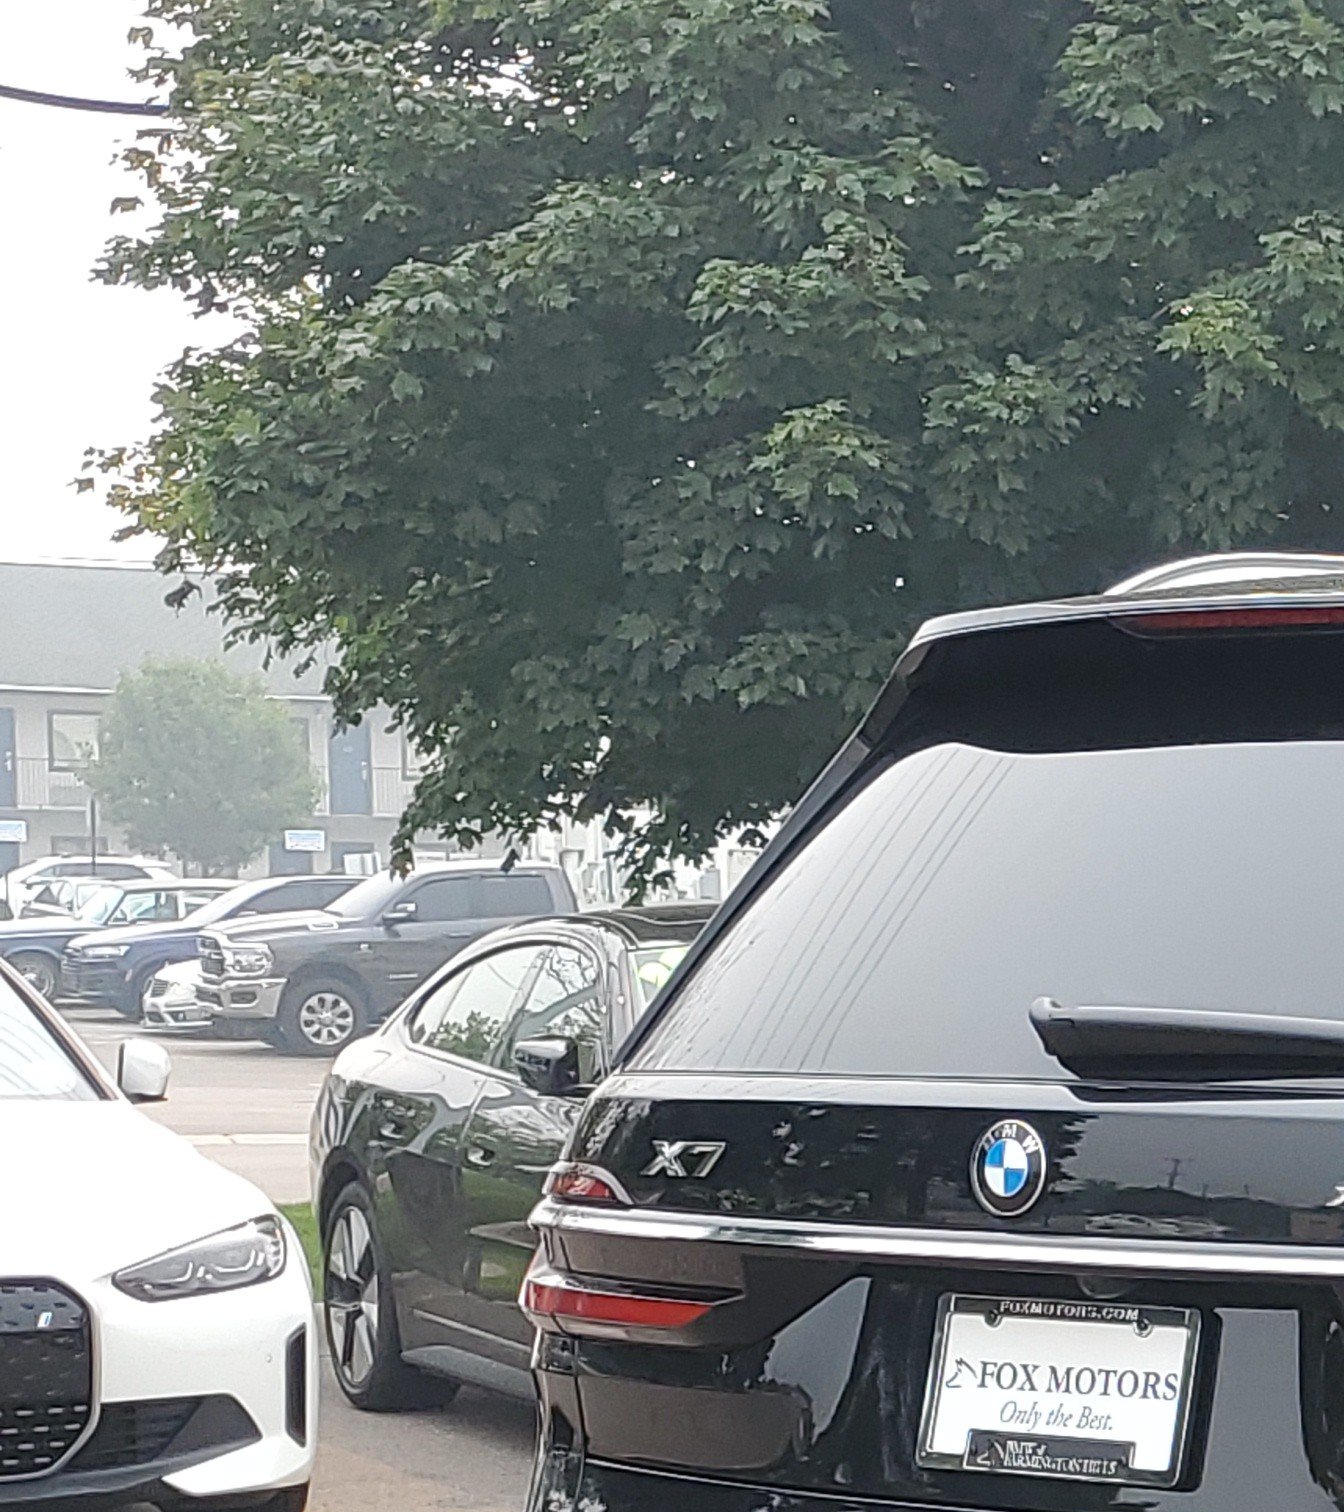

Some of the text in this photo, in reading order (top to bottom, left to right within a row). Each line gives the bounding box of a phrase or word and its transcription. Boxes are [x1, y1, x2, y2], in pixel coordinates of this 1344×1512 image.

[640, 1140, 727, 1178] X7
[999, 1300, 1140, 1321] FOXMOTORS.COM
[979, 1360, 1179, 1401] FOX MOTORS
[1000, 1400, 1114, 1431] Only the Best.
